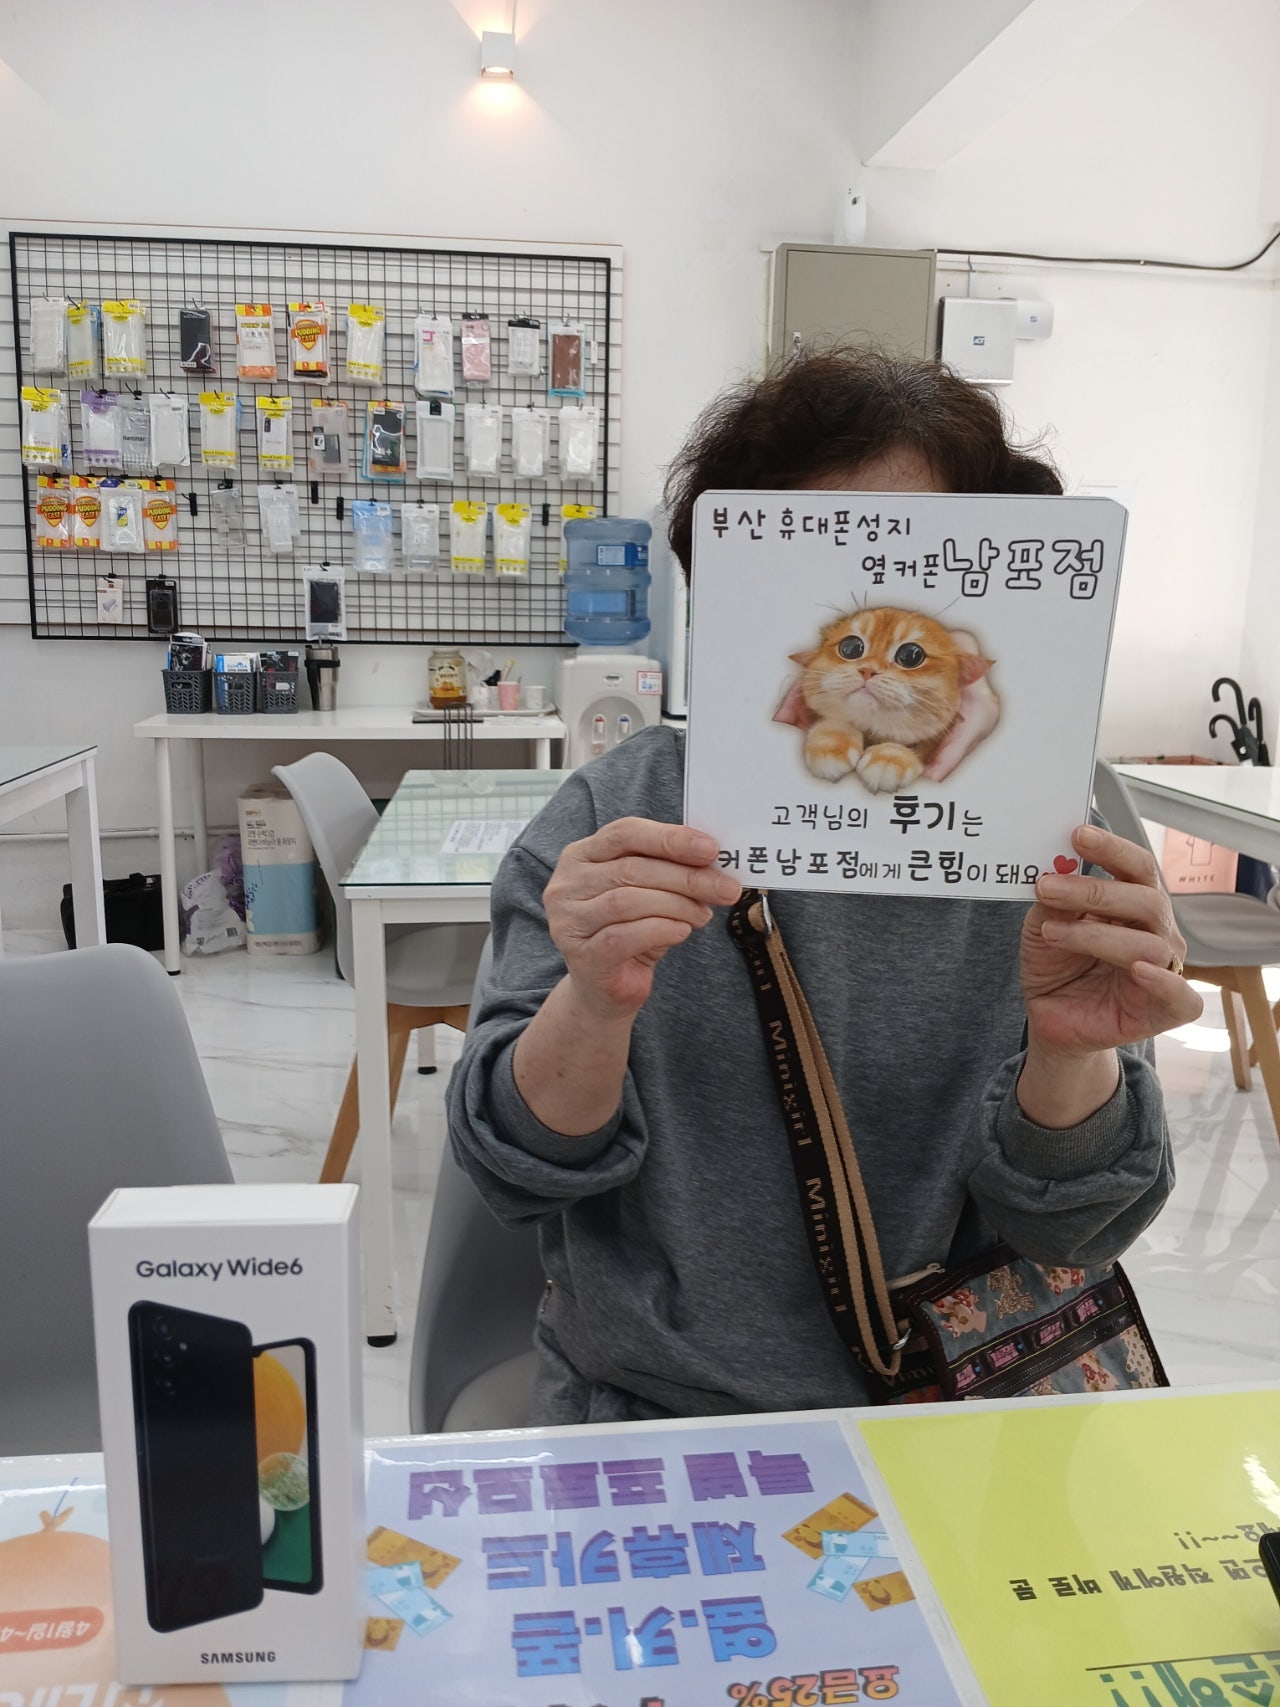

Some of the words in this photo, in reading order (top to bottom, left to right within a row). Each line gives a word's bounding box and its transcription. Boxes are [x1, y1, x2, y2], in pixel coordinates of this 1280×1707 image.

[41, 504, 67, 512] PUDDING
[147, 507, 172, 515] PUDDING
[712, 508, 766, 540] 부산
[779, 507, 910, 545] 휴대폰성지
[771, 804, 868, 830] 고객님의
[889, 795, 984, 837] 후기는
[1179, 874, 1215, 883] WHITE
[136, 1259, 223, 1281] Galaxy
[227, 1257, 304, 1276] Wide6
[408, 1457, 666, 1520] 프로모션
[683, 1450, 815, 1501] 특별
[481, 1521, 766, 1590] 제휴카드
[1009, 1579, 1037, 1601] 문
[1048, 1574, 1102, 1598] 바로
[1109, 1563, 1214, 1592] 직원에게
[200, 1651, 277, 1664] SAMSUNG
[727, 1664, 900, 1707] 요금25%
